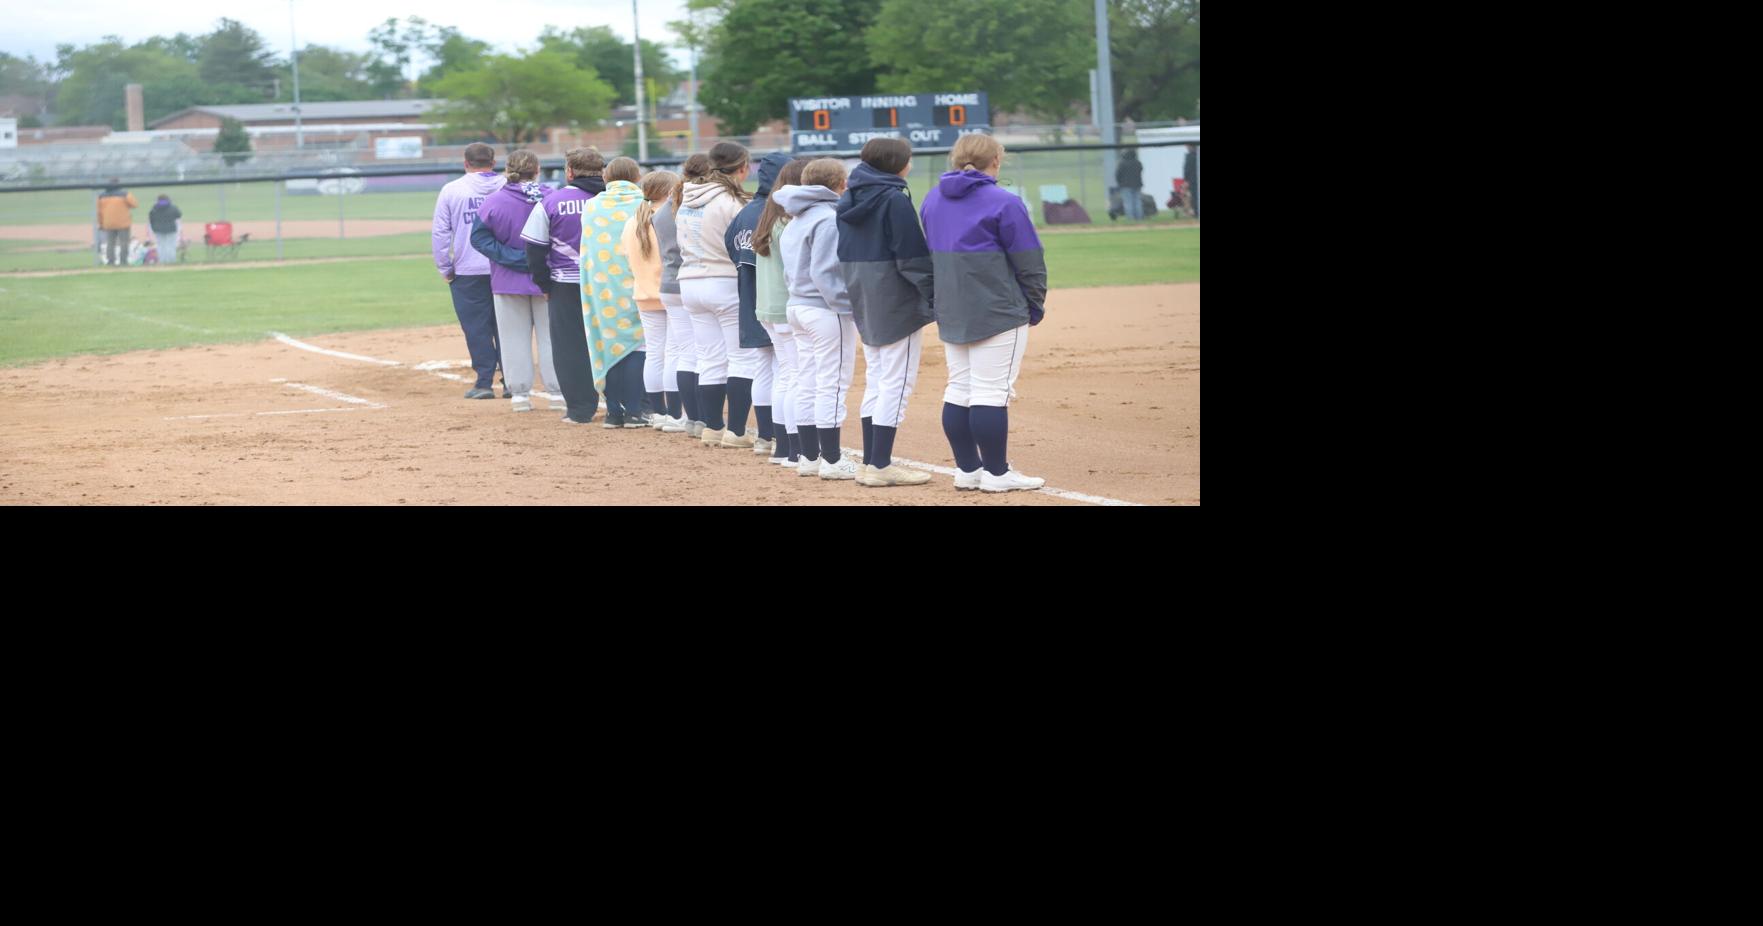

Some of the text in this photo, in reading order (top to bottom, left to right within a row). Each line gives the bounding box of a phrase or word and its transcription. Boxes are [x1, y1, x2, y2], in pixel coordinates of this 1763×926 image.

[793, 93, 979, 111] VISITOR INNING HOME
[814, 105, 965, 131] 0 1 0
[798, 134, 838, 146] BALL
[910, 130, 942, 142] OUT
